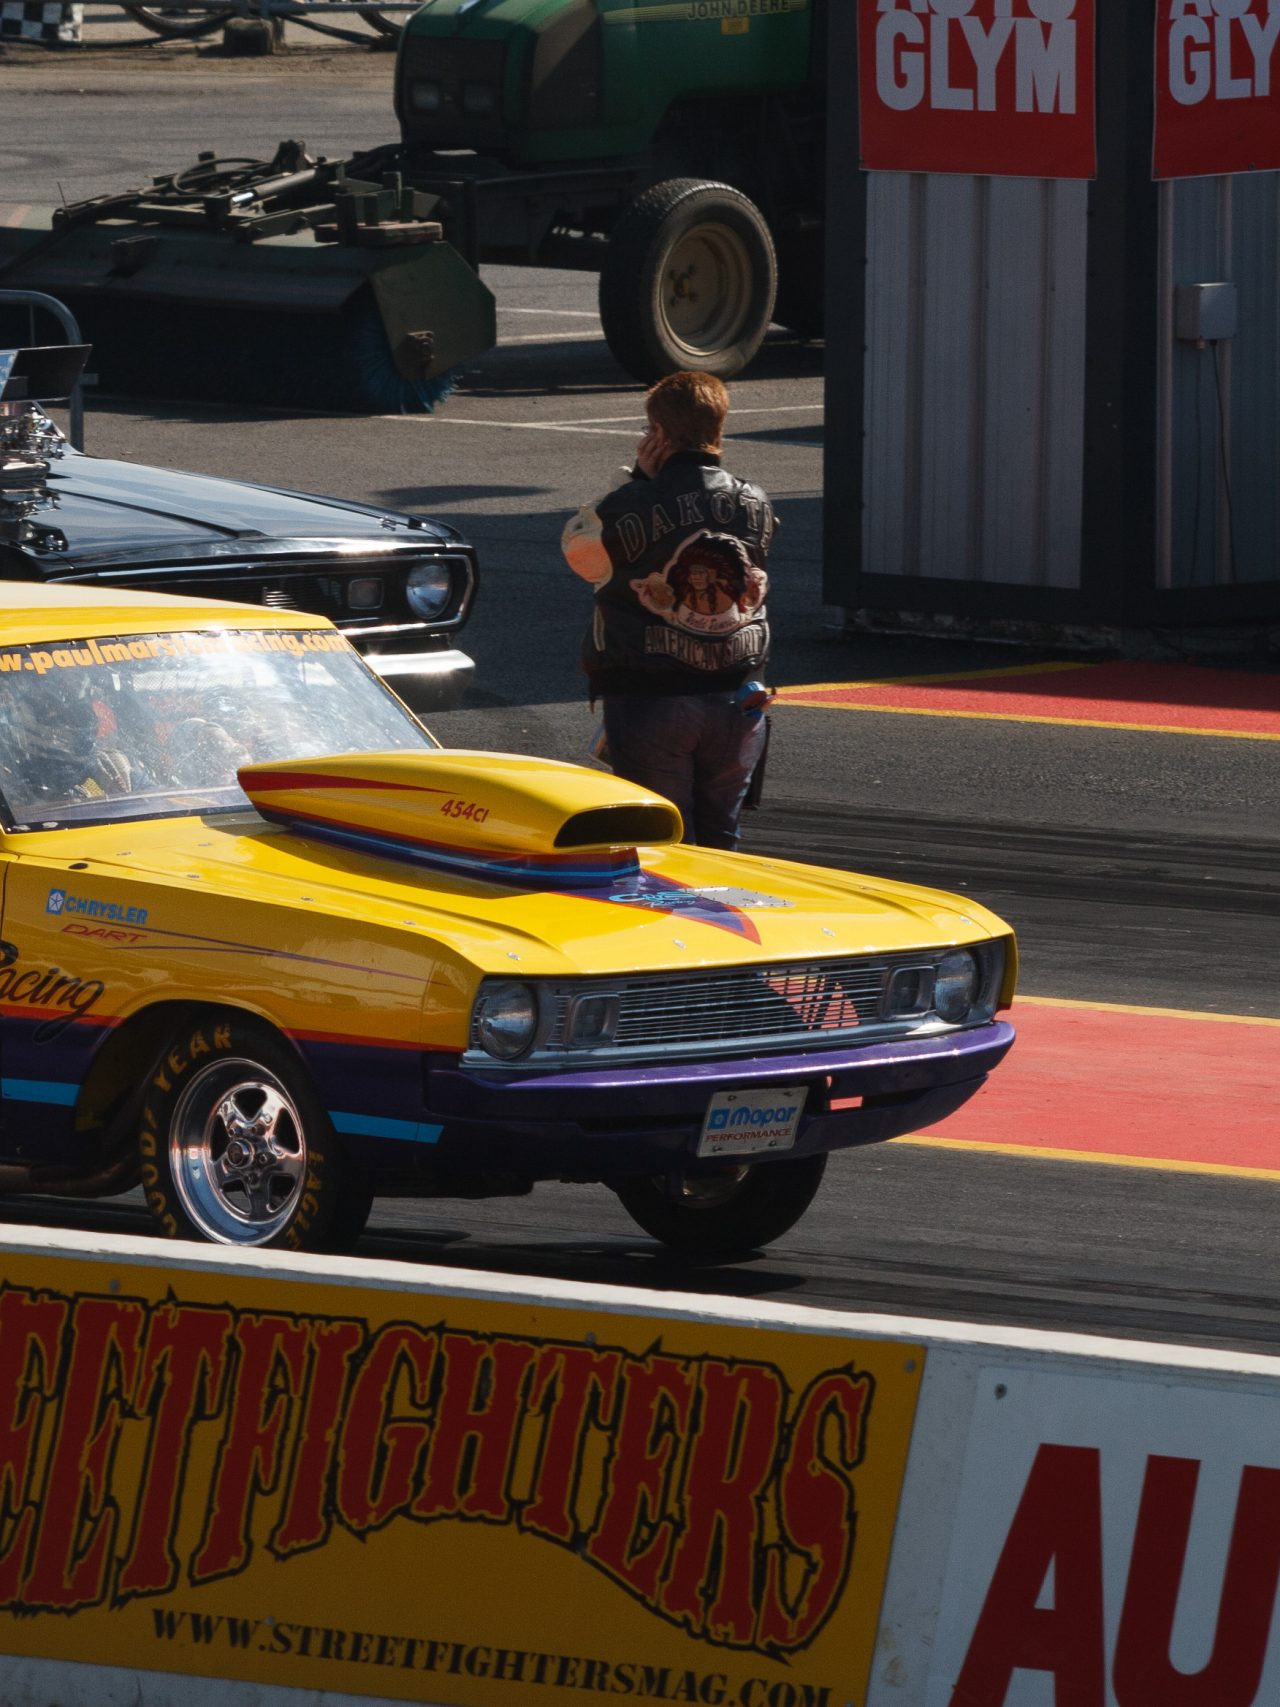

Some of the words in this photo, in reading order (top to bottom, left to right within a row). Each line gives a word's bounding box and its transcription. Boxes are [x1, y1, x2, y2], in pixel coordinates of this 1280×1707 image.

[688, 0, 733, 19] JOHN
[738, 0, 789, 16] DEERE
[876, 9, 1077, 115] GLYM
[65, 896, 148, 925] CHRYSLER
[61, 923, 148, 943] DART
[705, 1128, 793, 1143] PERFORMANCE
[947, 1442, 1280, 1707] AU
[150, 1607, 833, 1707] WWW.STREETFIGHTERSMAG.COM
